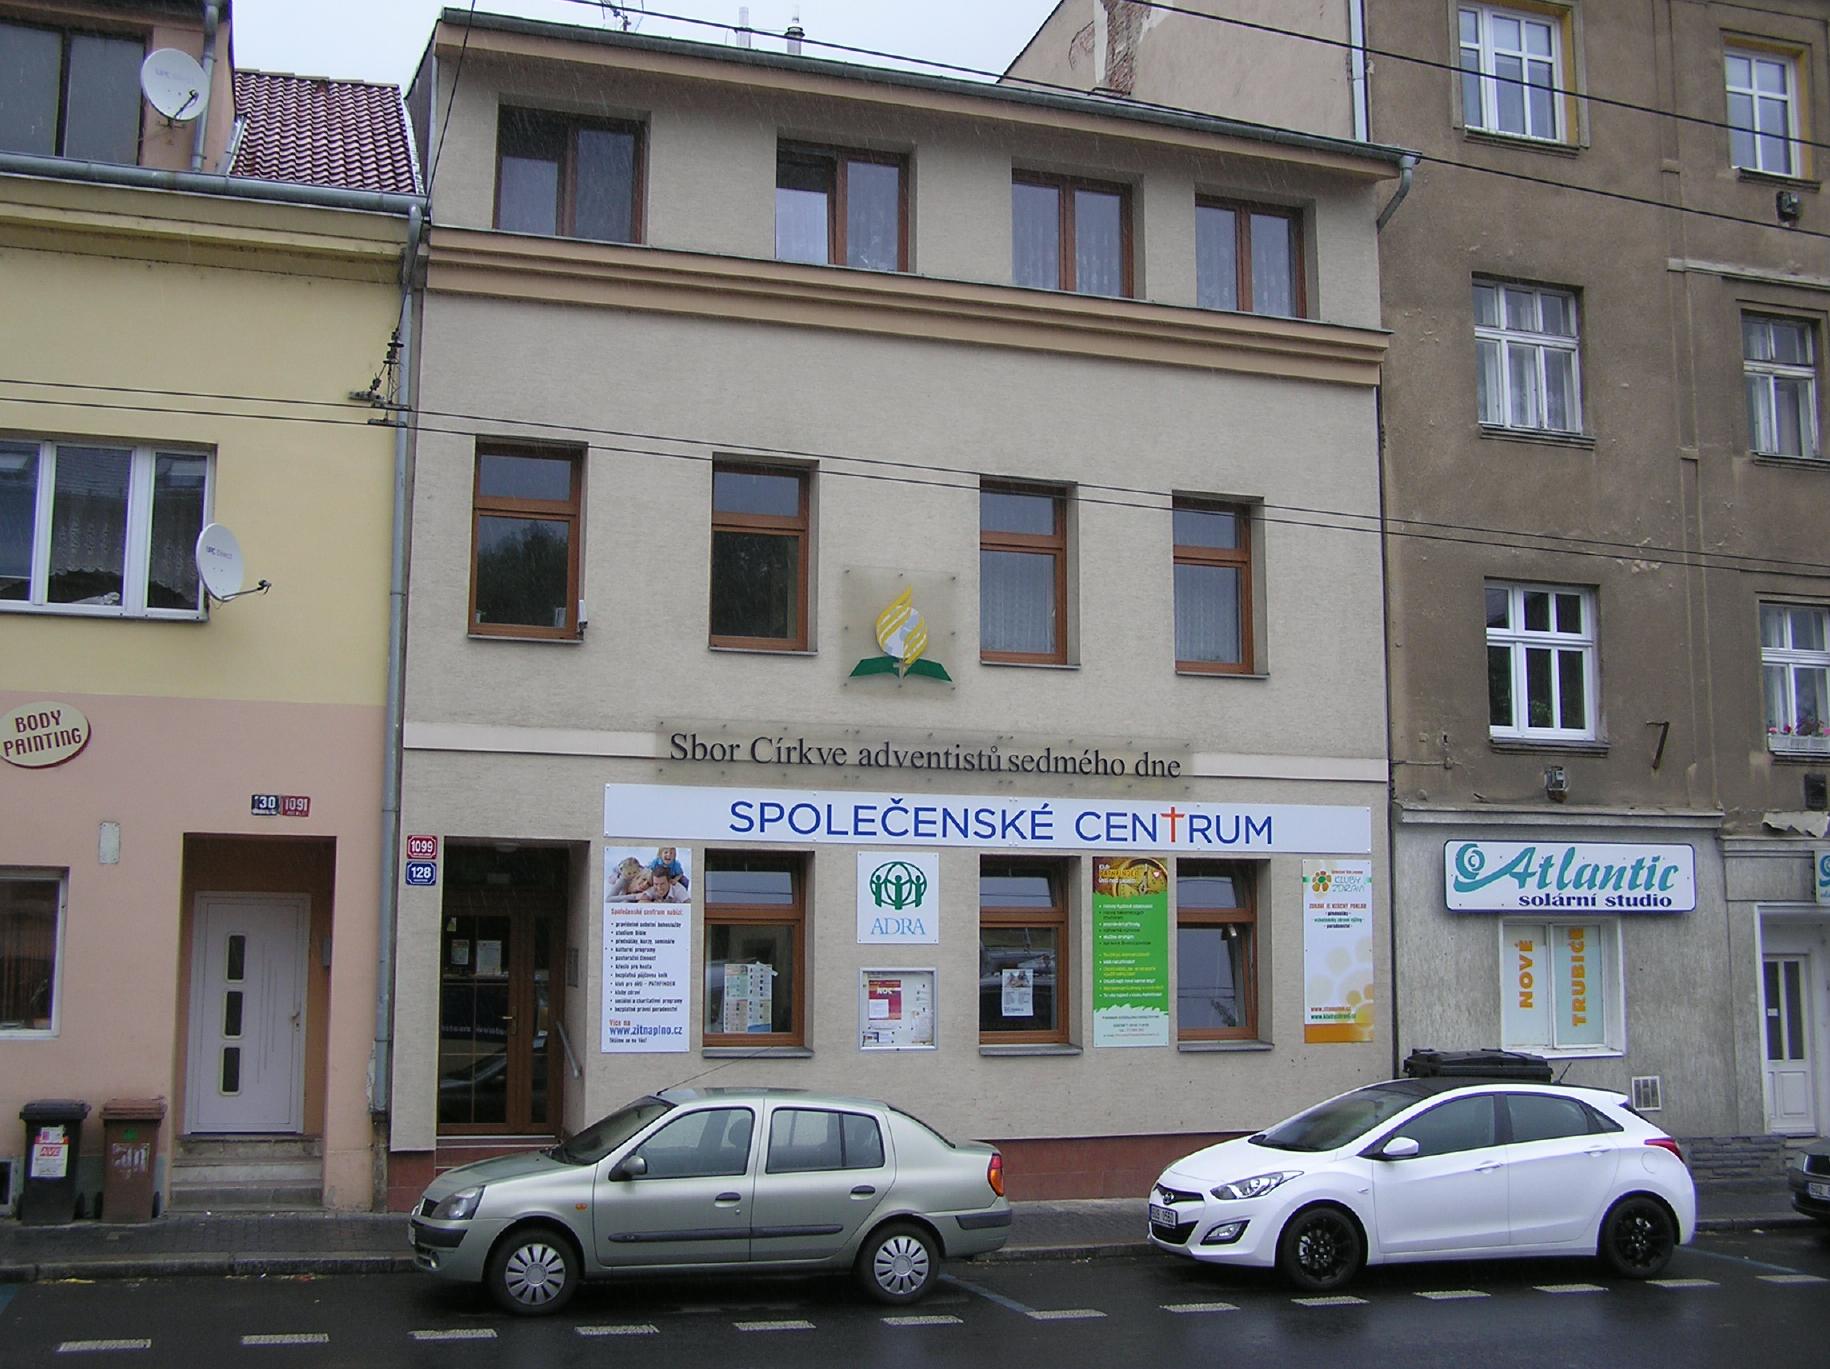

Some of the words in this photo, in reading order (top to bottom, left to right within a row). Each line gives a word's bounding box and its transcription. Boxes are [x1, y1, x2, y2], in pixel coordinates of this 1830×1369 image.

[15, 709, 61, 733] BODY
[3, 727, 82, 757] PAINTING
[670, 733, 740, 762] Sbor
[750, 736, 848, 766] Církve
[858, 740, 1001, 771] adventistů
[1008, 747, 1125, 777] sedmého
[1135, 751, 1181, 778] dne
[285, 798, 309, 811] 1091
[729, 797, 1054, 841] SPOLEČENSKÉ
[411, 840, 433, 853] 1099
[411, 866, 431, 879] 128
[1453, 845, 1679, 893] Atlantic
[1518, 892, 1597, 907] solární
[1605, 893, 1672, 907] studio
[870, 917, 926, 936] ADRA
[1514, 940, 1533, 1008] NOVÉ
